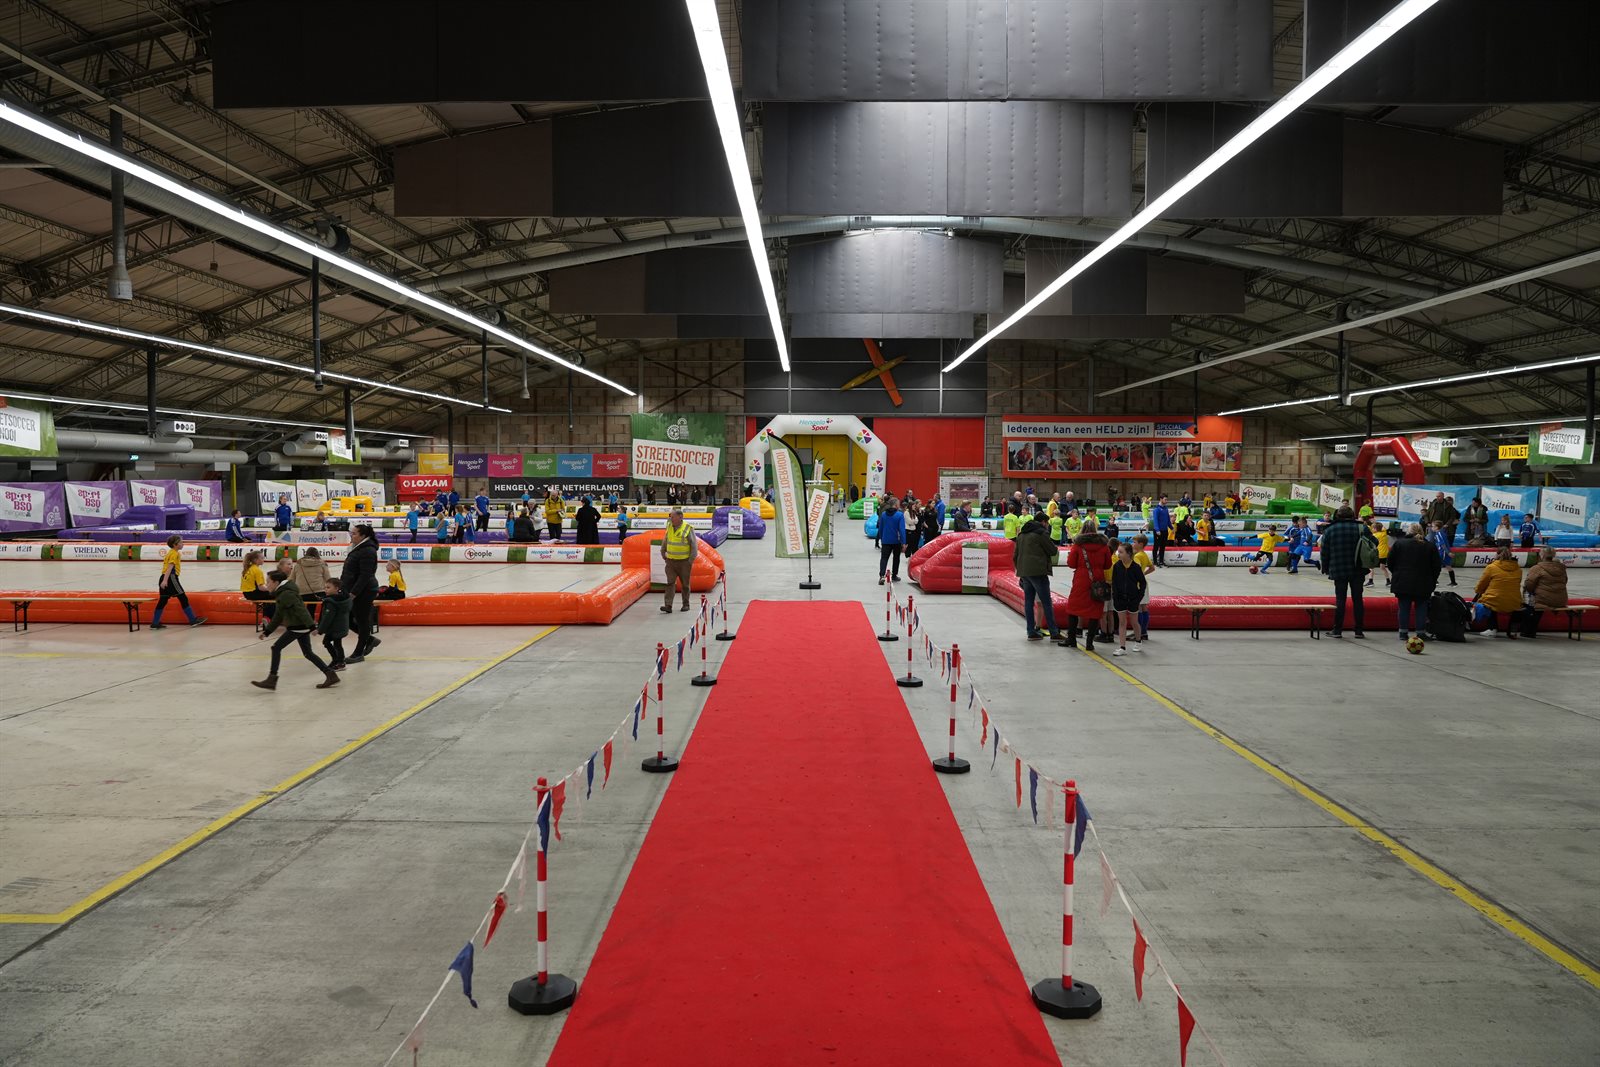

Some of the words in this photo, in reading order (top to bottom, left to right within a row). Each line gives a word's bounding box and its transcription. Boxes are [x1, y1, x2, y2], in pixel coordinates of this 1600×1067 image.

[1007, 424, 1050, 434] Iedereen
[1053, 425, 1071, 434] kan
[1074, 426, 1092, 434] een
[1095, 425, 1124, 434] HELD
[1128, 425, 1150, 436] zijn!
[1543, 432, 1581, 445] STREETSOCCER
[1508, 446, 1528, 456] TOILET
[1542, 442, 1566, 454] TOERNOOI
[636, 444, 715, 467] STREETSOCCER
[635, 460, 687, 479] TOERNOOI
[411, 479, 448, 487] LOXAM
[298, 536, 328, 544] Hengelo
[73, 546, 108, 554] VRIELING
[225, 548, 243, 557] toff
